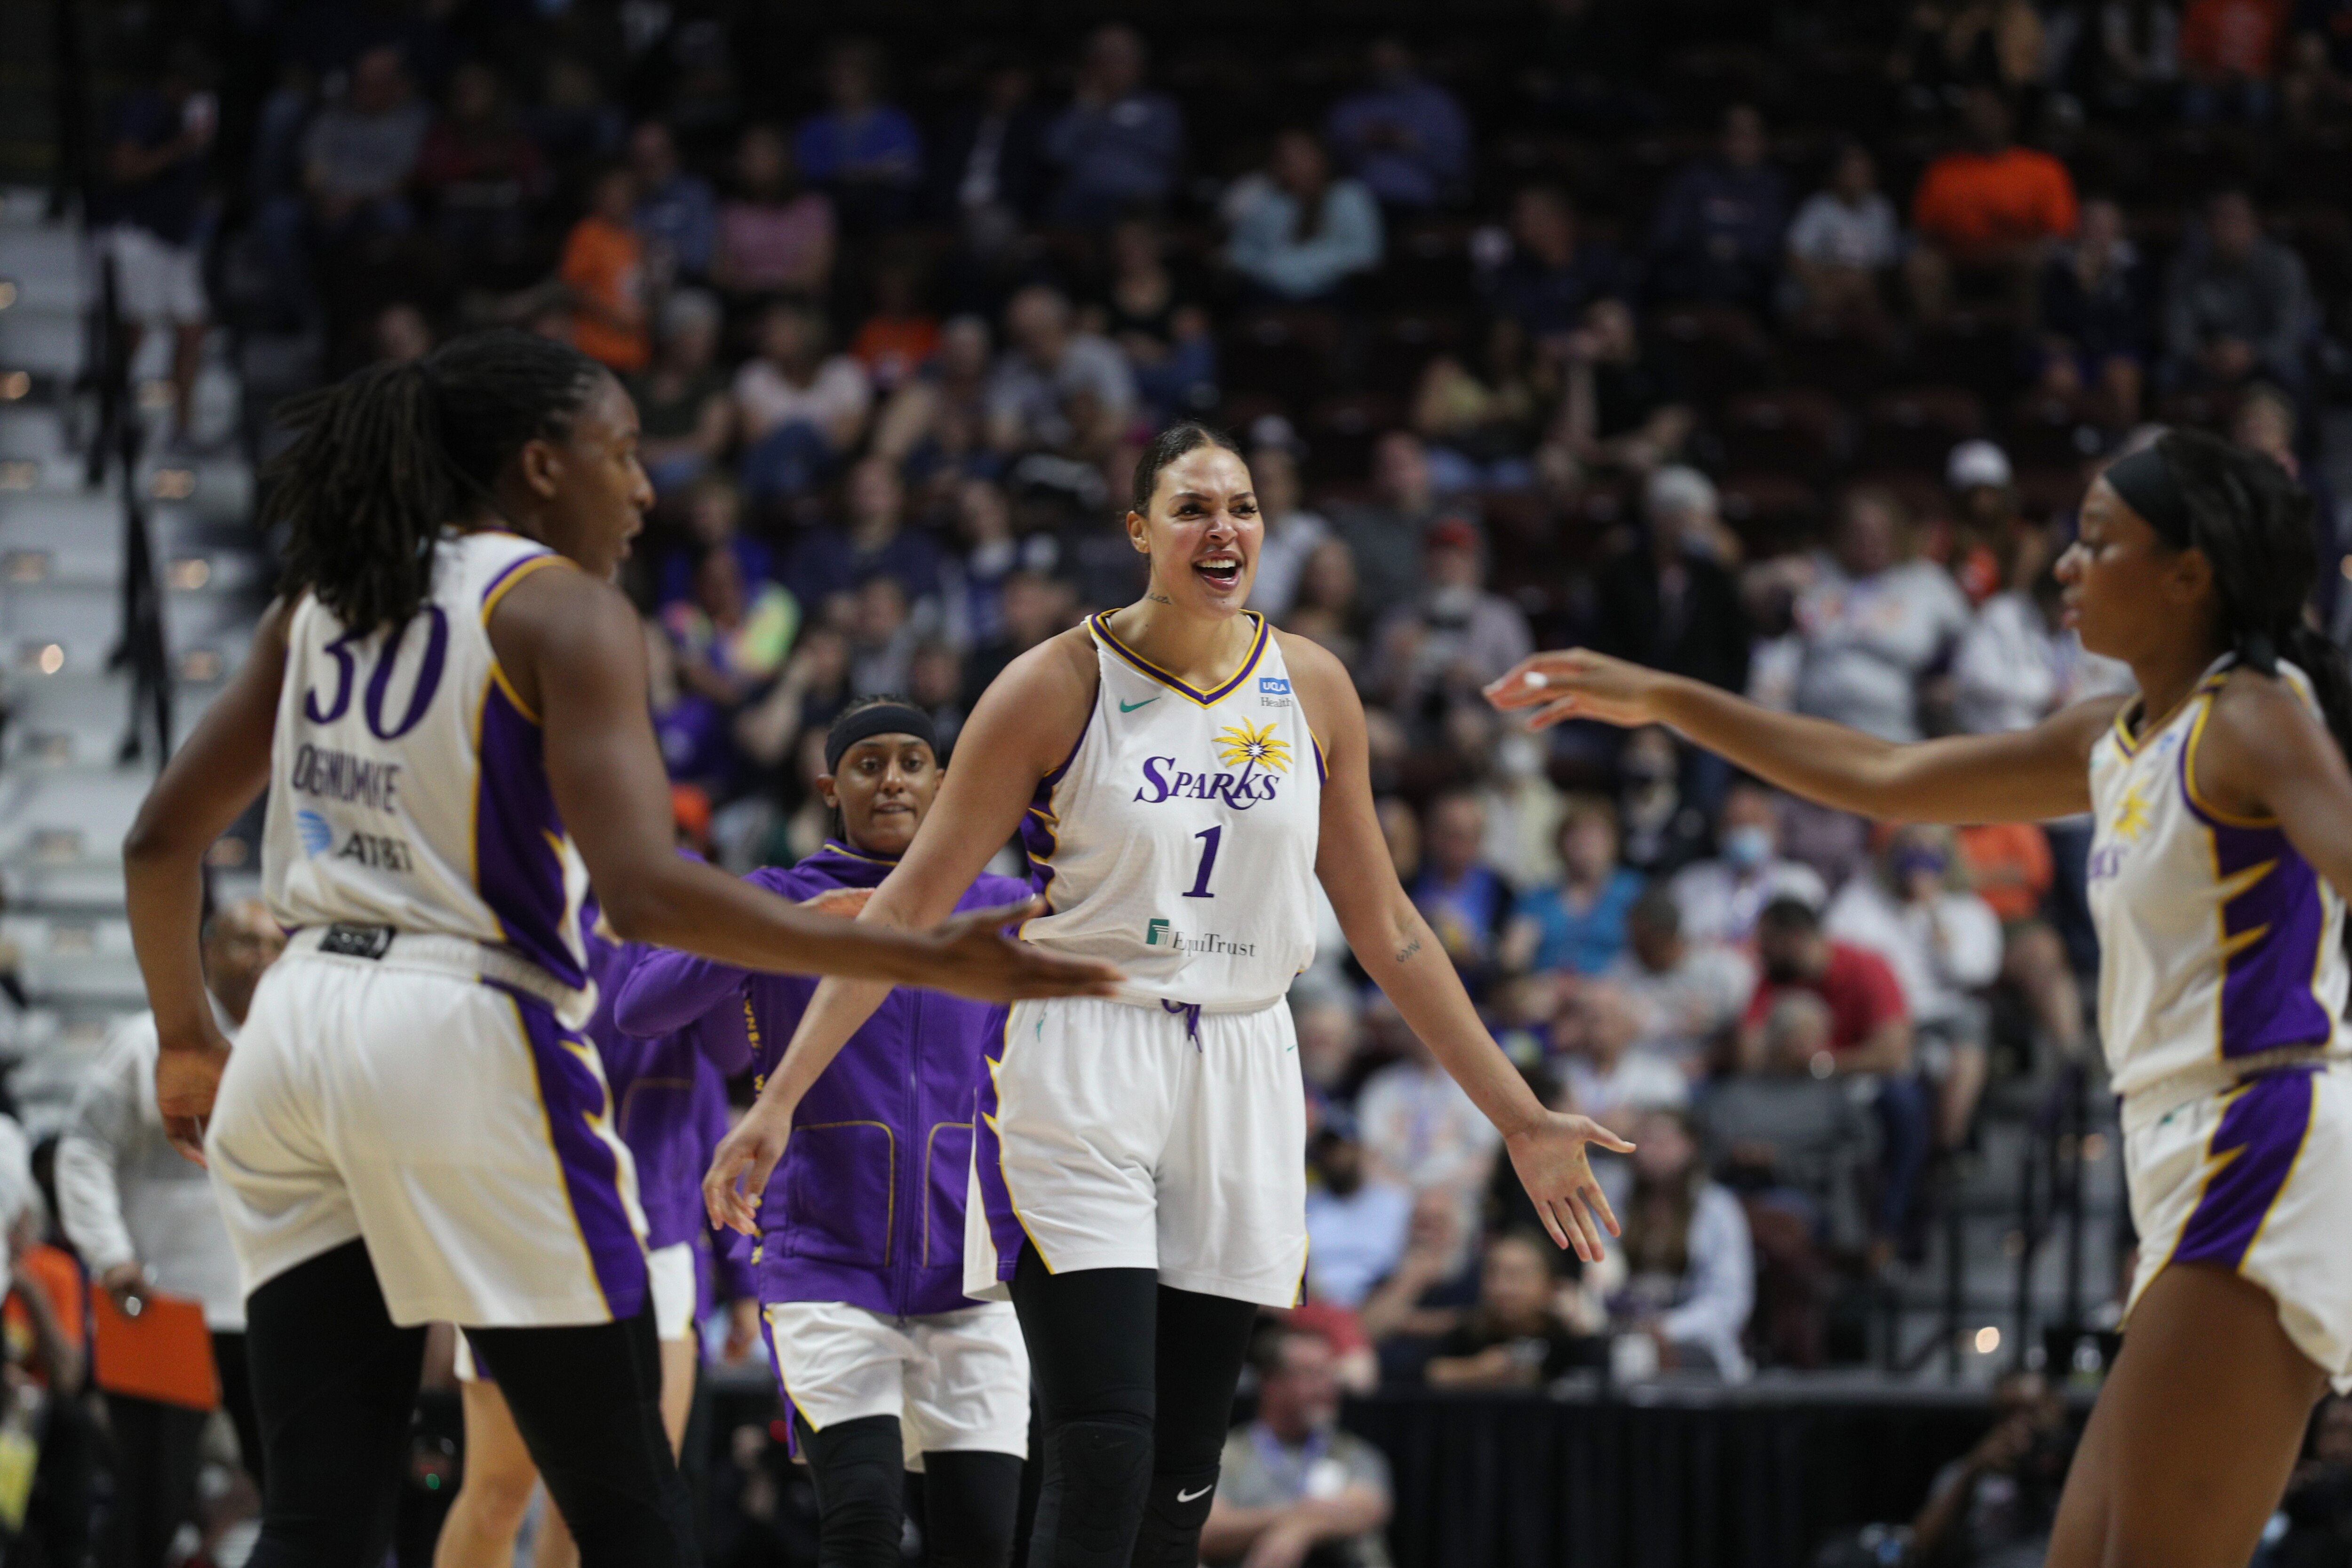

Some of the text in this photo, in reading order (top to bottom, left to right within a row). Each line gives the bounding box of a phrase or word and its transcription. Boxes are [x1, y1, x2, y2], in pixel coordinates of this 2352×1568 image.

[304, 604, 449, 741] 30
[1262, 682, 1287, 692] UCLA
[1261, 697, 1293, 708] Health
[337, 831, 413, 871] AT&T
[1182, 825, 1222, 898] 1
[1172, 931, 1257, 957] EquiTrust
